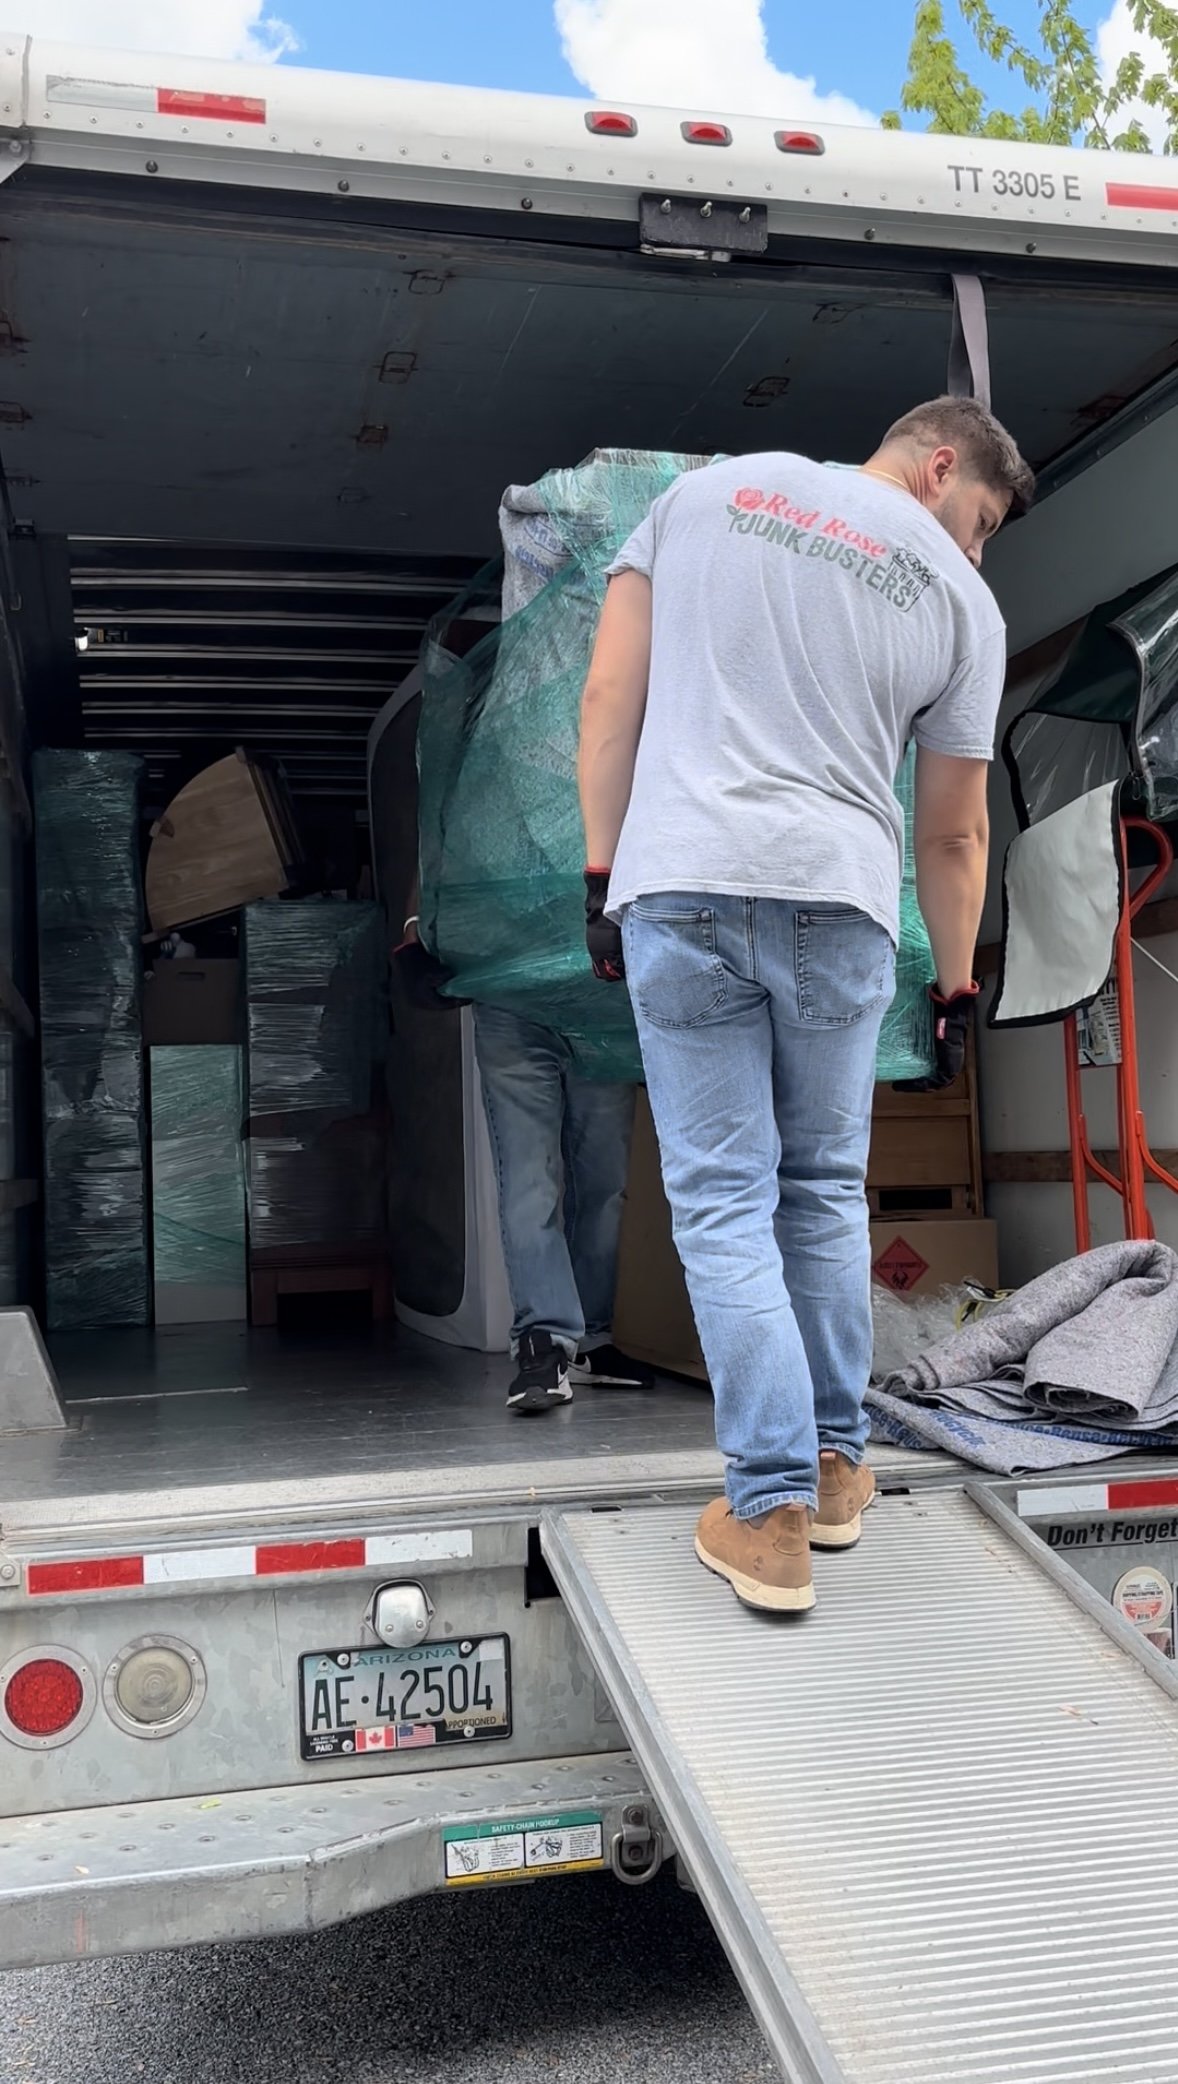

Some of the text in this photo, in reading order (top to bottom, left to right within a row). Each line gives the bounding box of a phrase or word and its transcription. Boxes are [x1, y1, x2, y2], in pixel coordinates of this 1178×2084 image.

[947, 165, 1081, 200] TT 3305 E
[763, 493, 887, 558] Red Rose
[738, 513, 911, 608] JUNK BUSTERS
[1047, 1517, 1178, 1546] Don't Forget
[354, 1648, 456, 1667] ARIZONA
[315, 1744, 334, 1753] PAID
